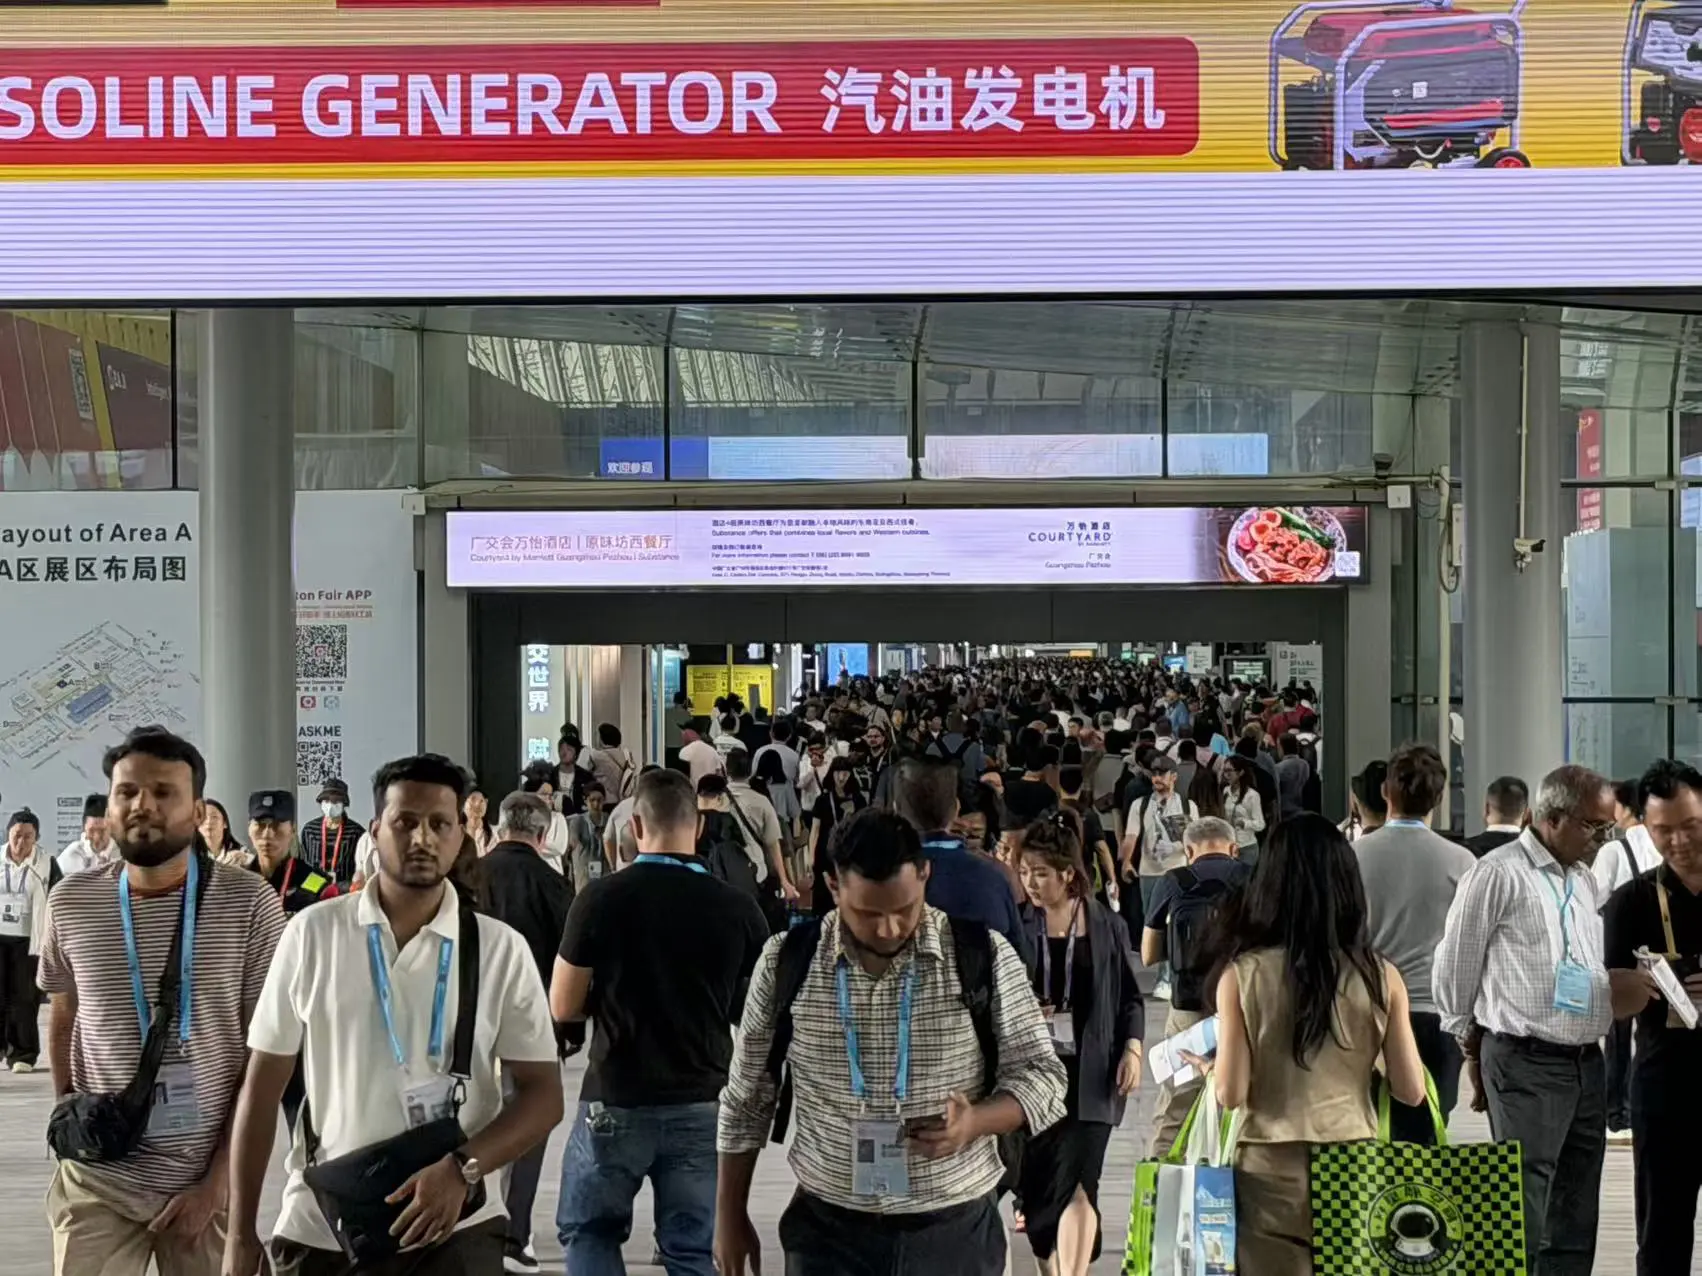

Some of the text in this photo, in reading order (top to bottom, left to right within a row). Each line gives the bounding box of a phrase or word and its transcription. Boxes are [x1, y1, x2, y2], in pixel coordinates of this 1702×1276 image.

[0, 70, 782, 140] SOLINE GENERATOR
[821, 65, 1166, 134] 汽油发电机
[2, 522, 192, 548] ayout of Area A
[470, 534, 673, 550] 广交会万怡酒店 原味坊西餐厅
[1028, 532, 1111, 542] COURTYARD
[0, 556, 186, 582] A区展区布局图
[318, 588, 343, 600] Fair
[346, 589, 372, 601] APP
[298, 725, 342, 737] ASKME
